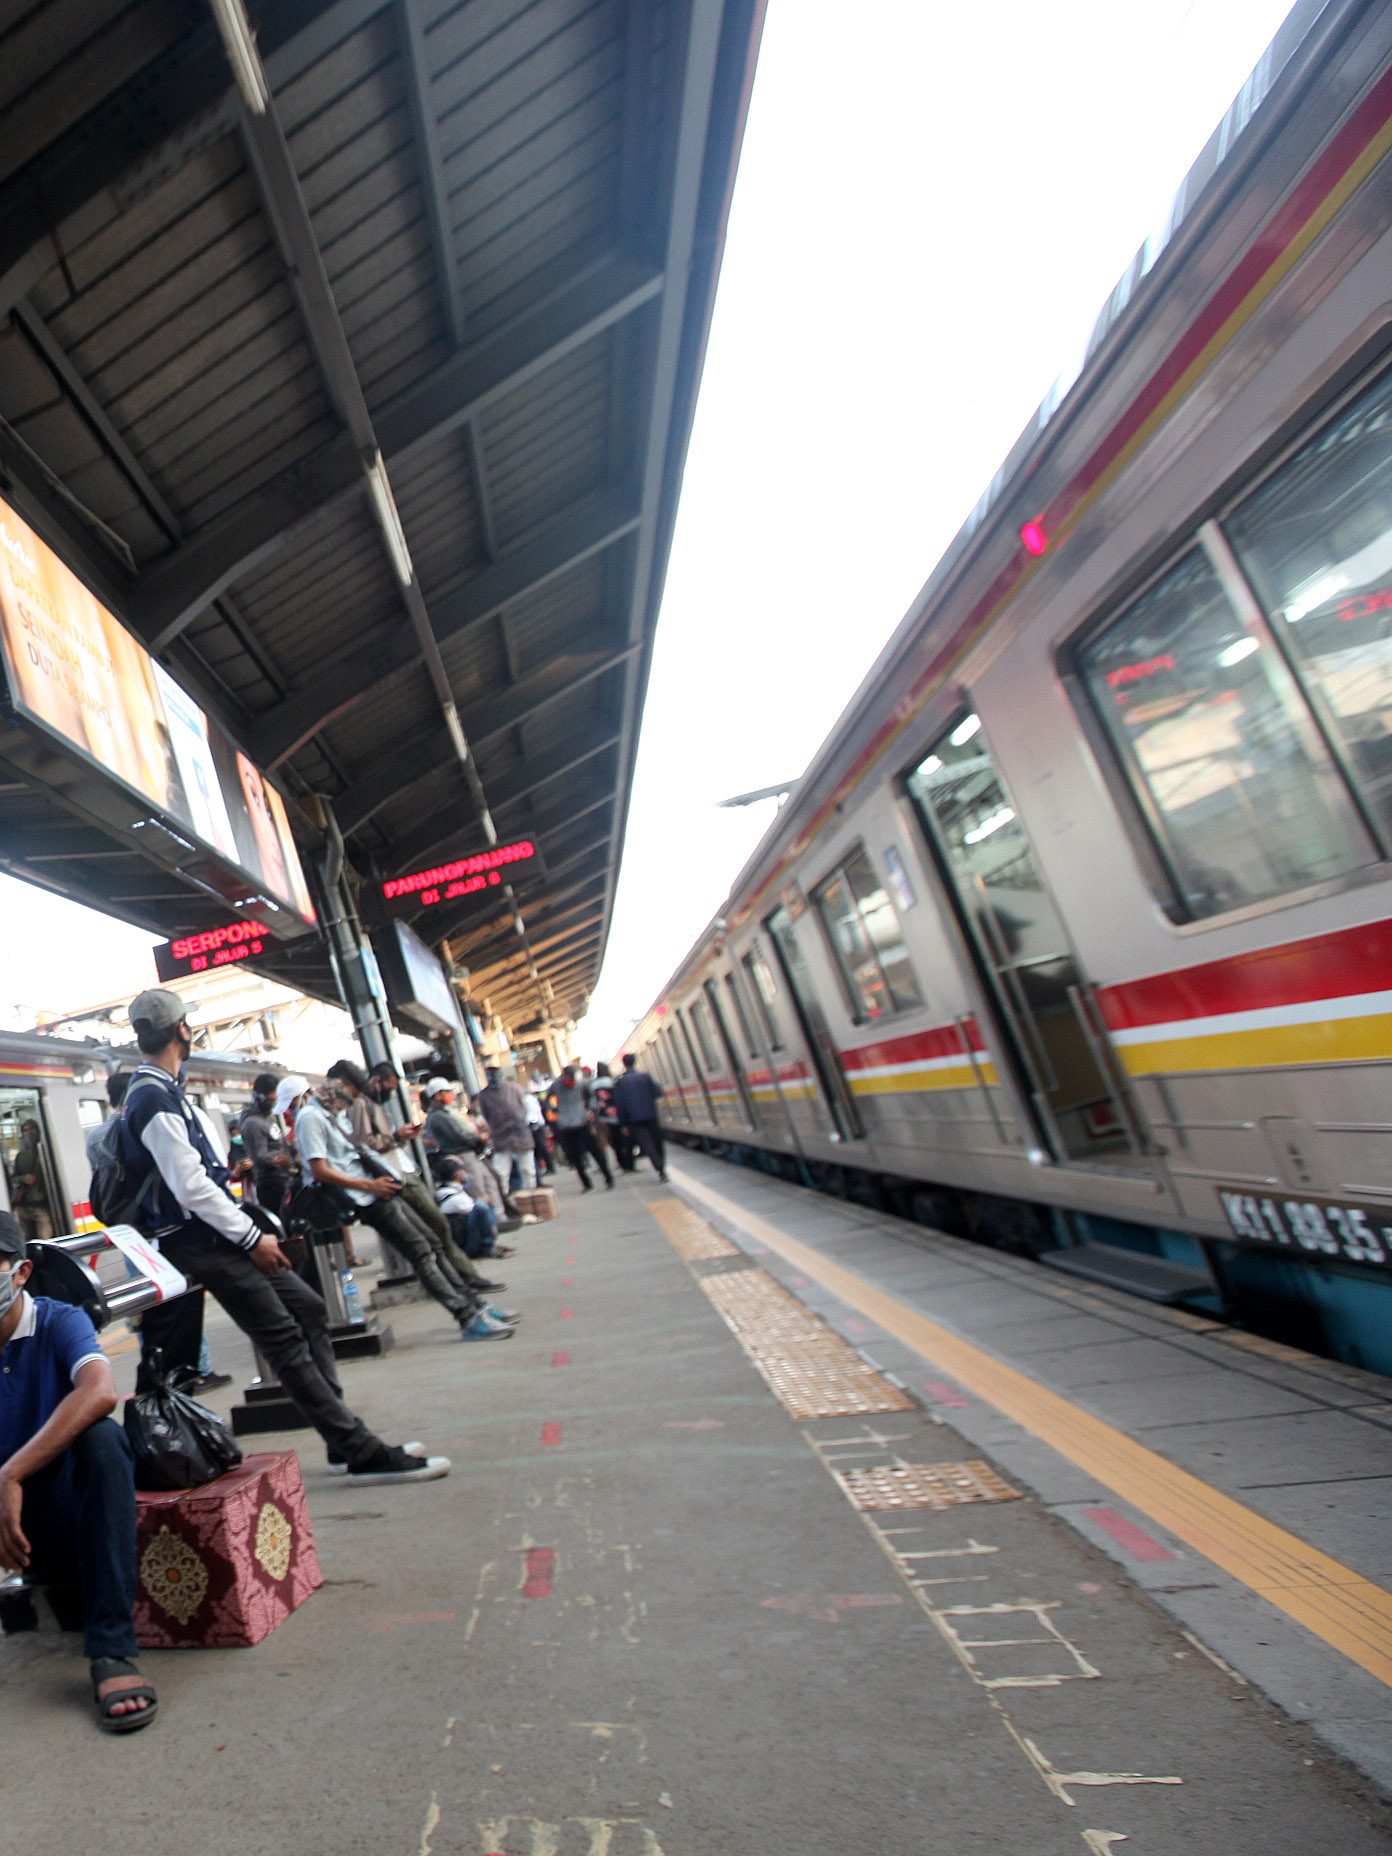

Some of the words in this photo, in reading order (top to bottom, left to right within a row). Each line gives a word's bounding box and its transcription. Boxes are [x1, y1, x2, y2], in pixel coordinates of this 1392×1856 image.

[421, 889, 441, 905] DI
[191, 955, 208, 971] DI
[212, 944, 250, 965] JALUR
